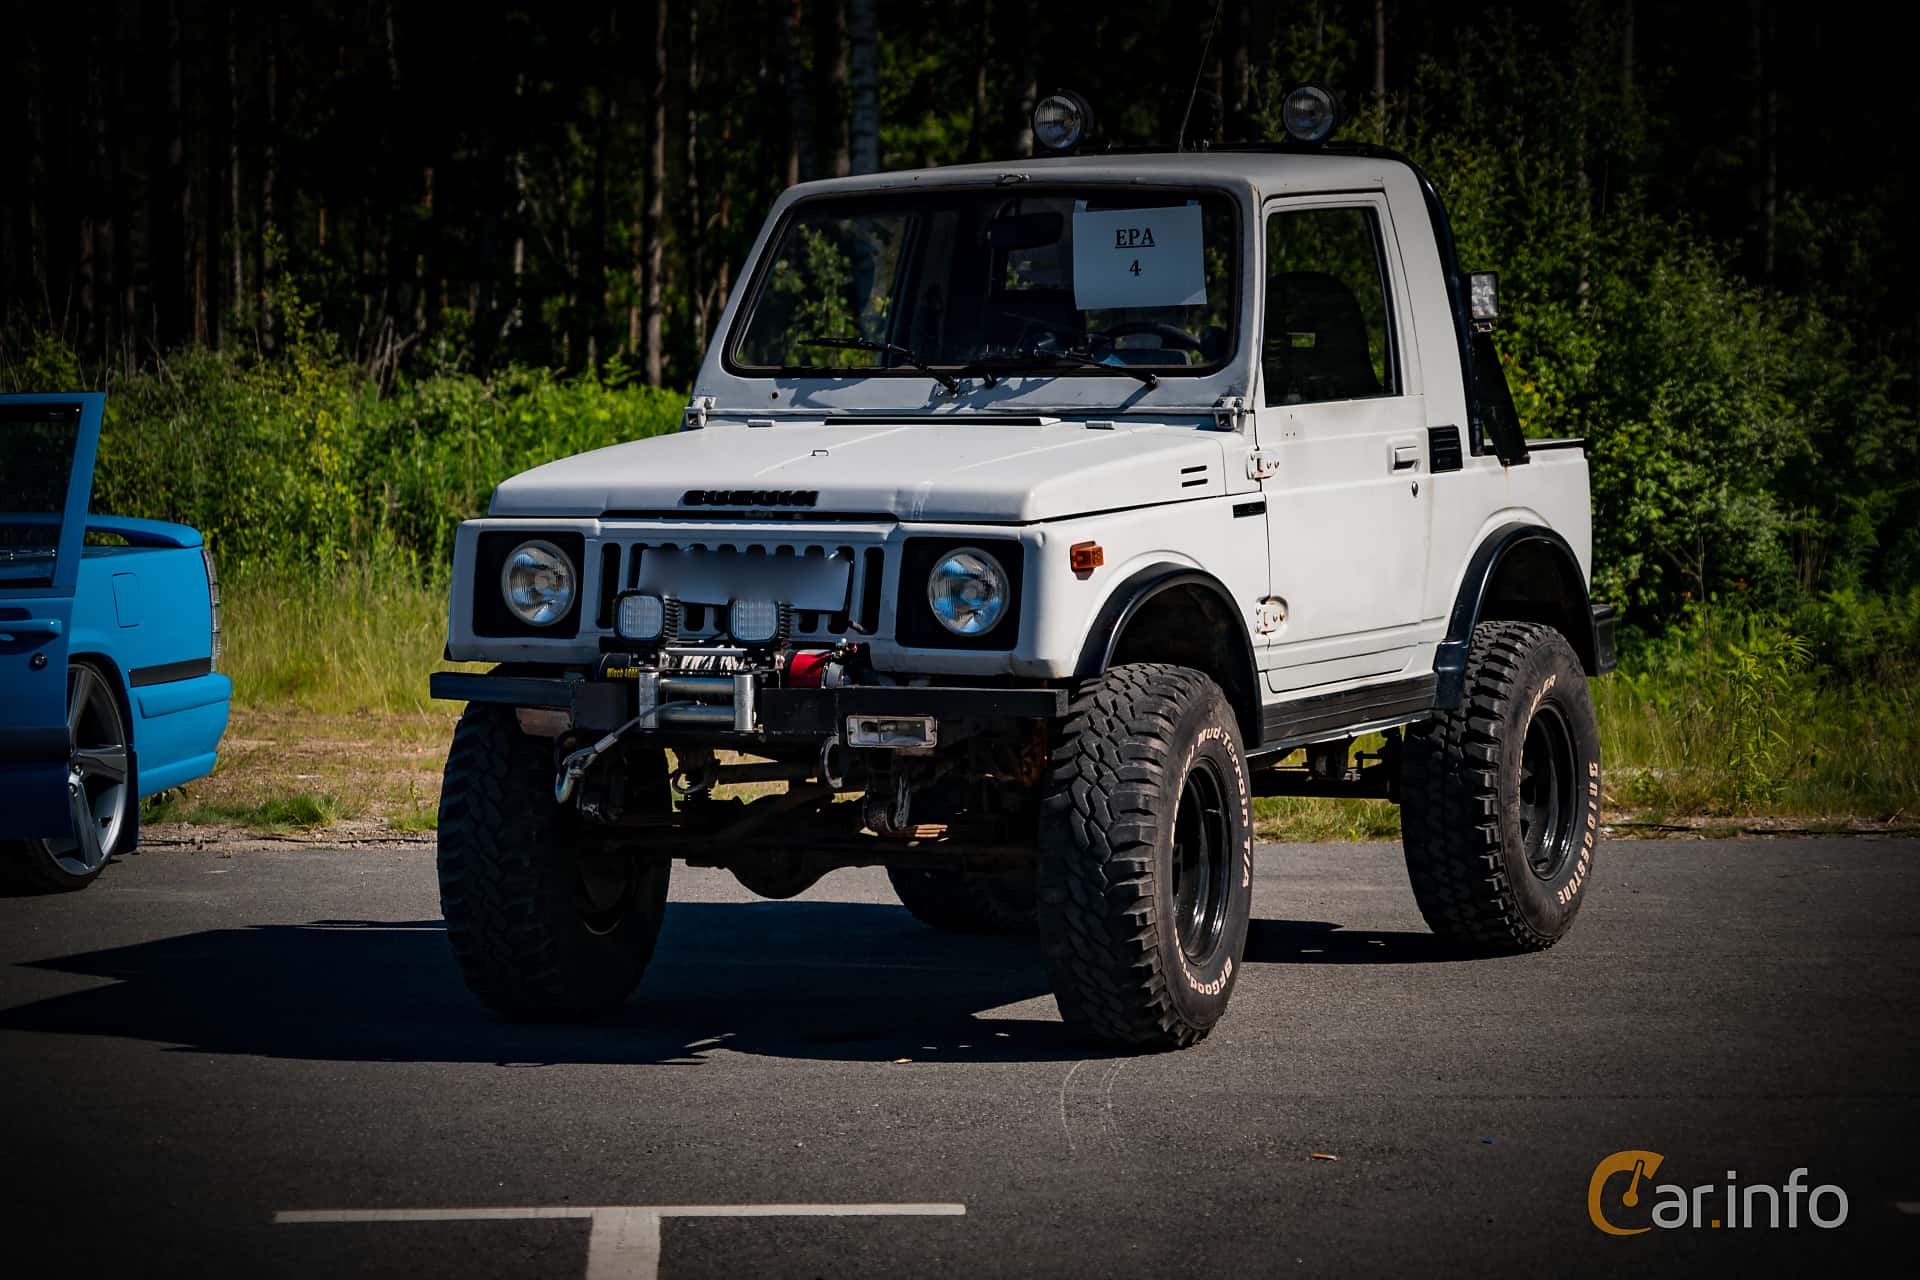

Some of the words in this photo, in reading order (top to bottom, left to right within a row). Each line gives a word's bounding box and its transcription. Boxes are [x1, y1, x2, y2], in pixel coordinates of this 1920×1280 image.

[1115, 228, 1155, 247] EPA
[1128, 260, 1142, 277] 4
[1197, 726, 1249, 827] Mud-Terrain
[1241, 836, 1251, 888] T/A
